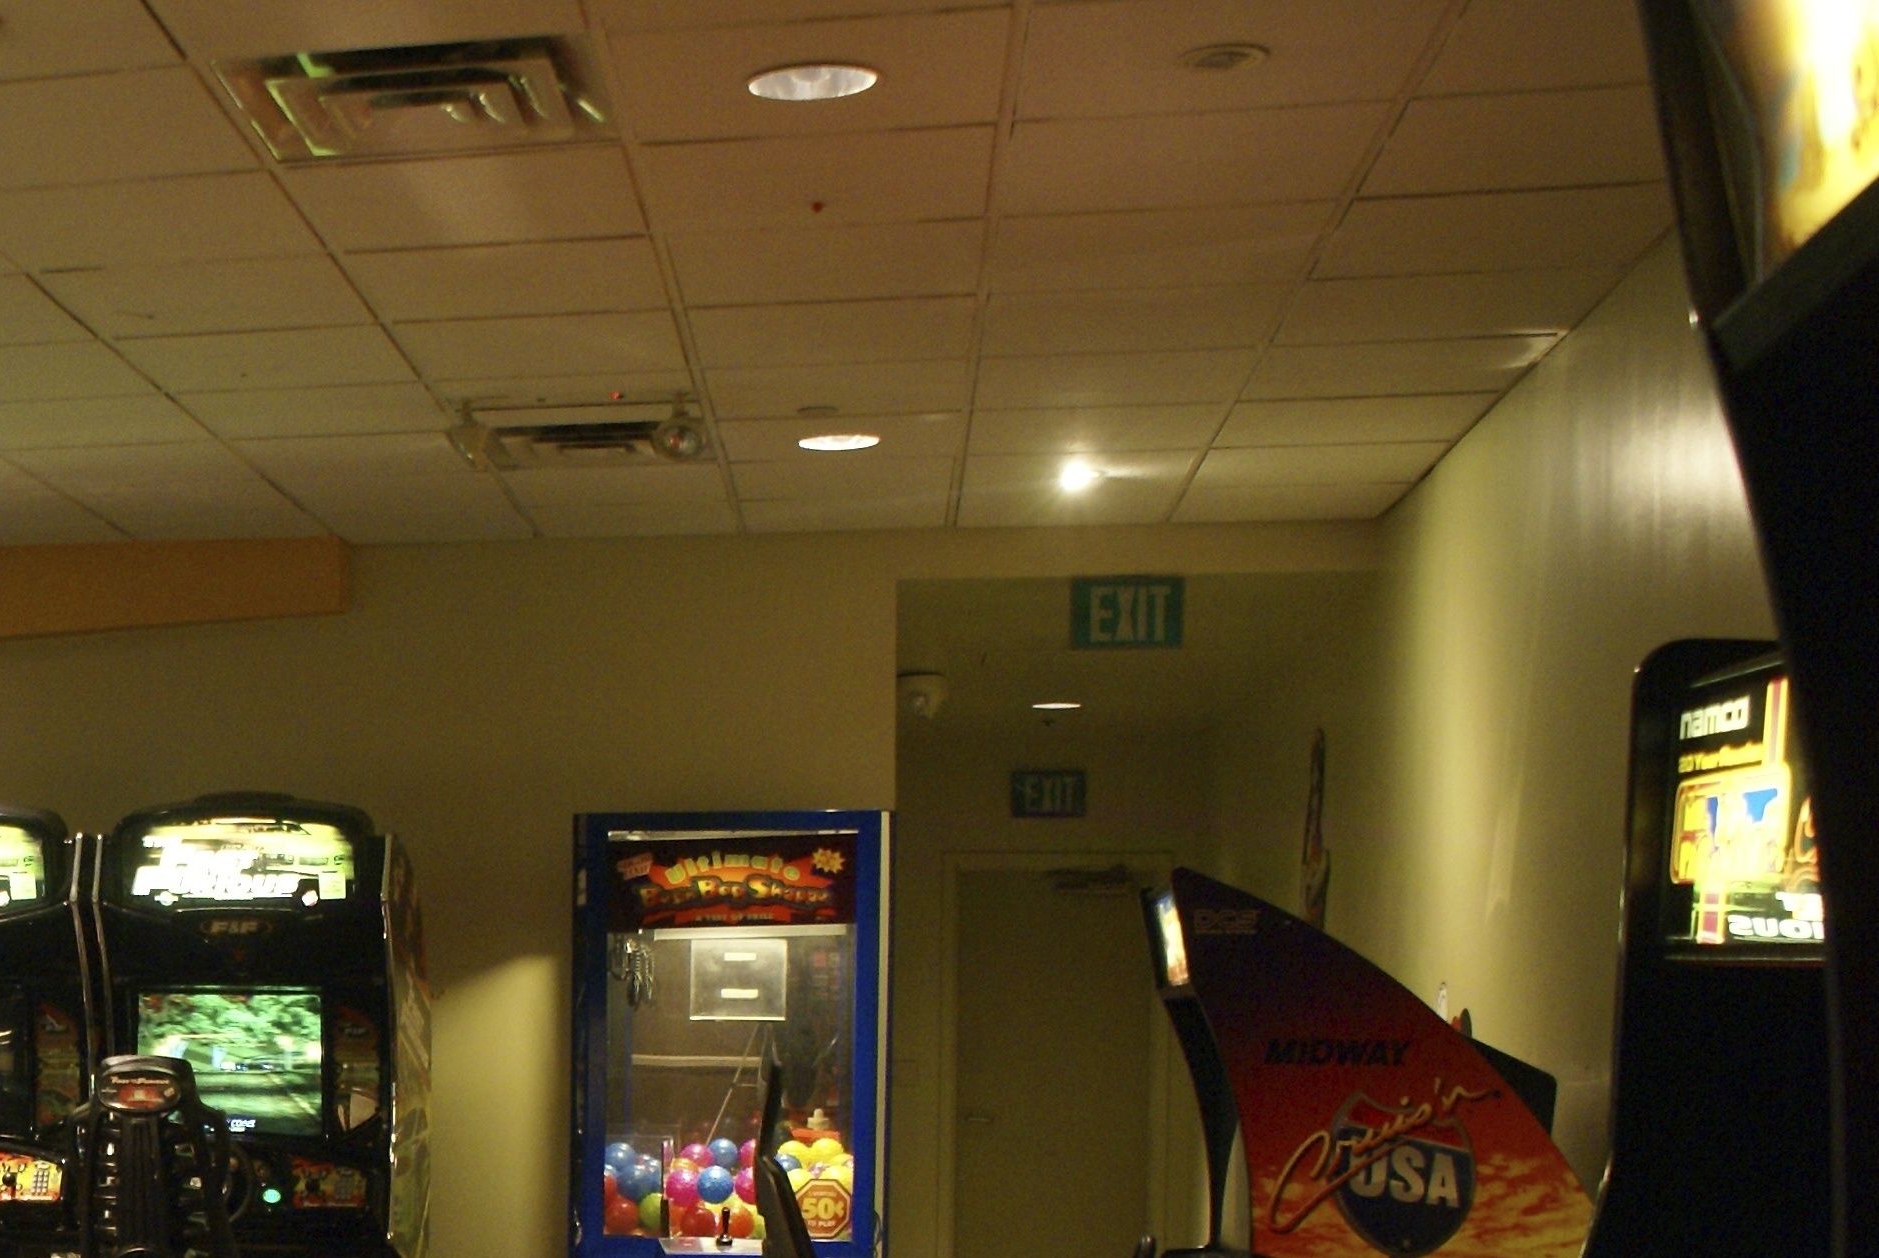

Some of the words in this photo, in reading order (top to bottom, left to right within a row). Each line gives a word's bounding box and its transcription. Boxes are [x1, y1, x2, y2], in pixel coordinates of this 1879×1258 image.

[1090, 585, 1171, 641] EXIT
[1680, 697, 1750, 740] namco
[1024, 776, 1078, 809] EXIT
[1266, 1040, 1415, 1065] MIDWAY
[1349, 1144, 1460, 1209] USA
